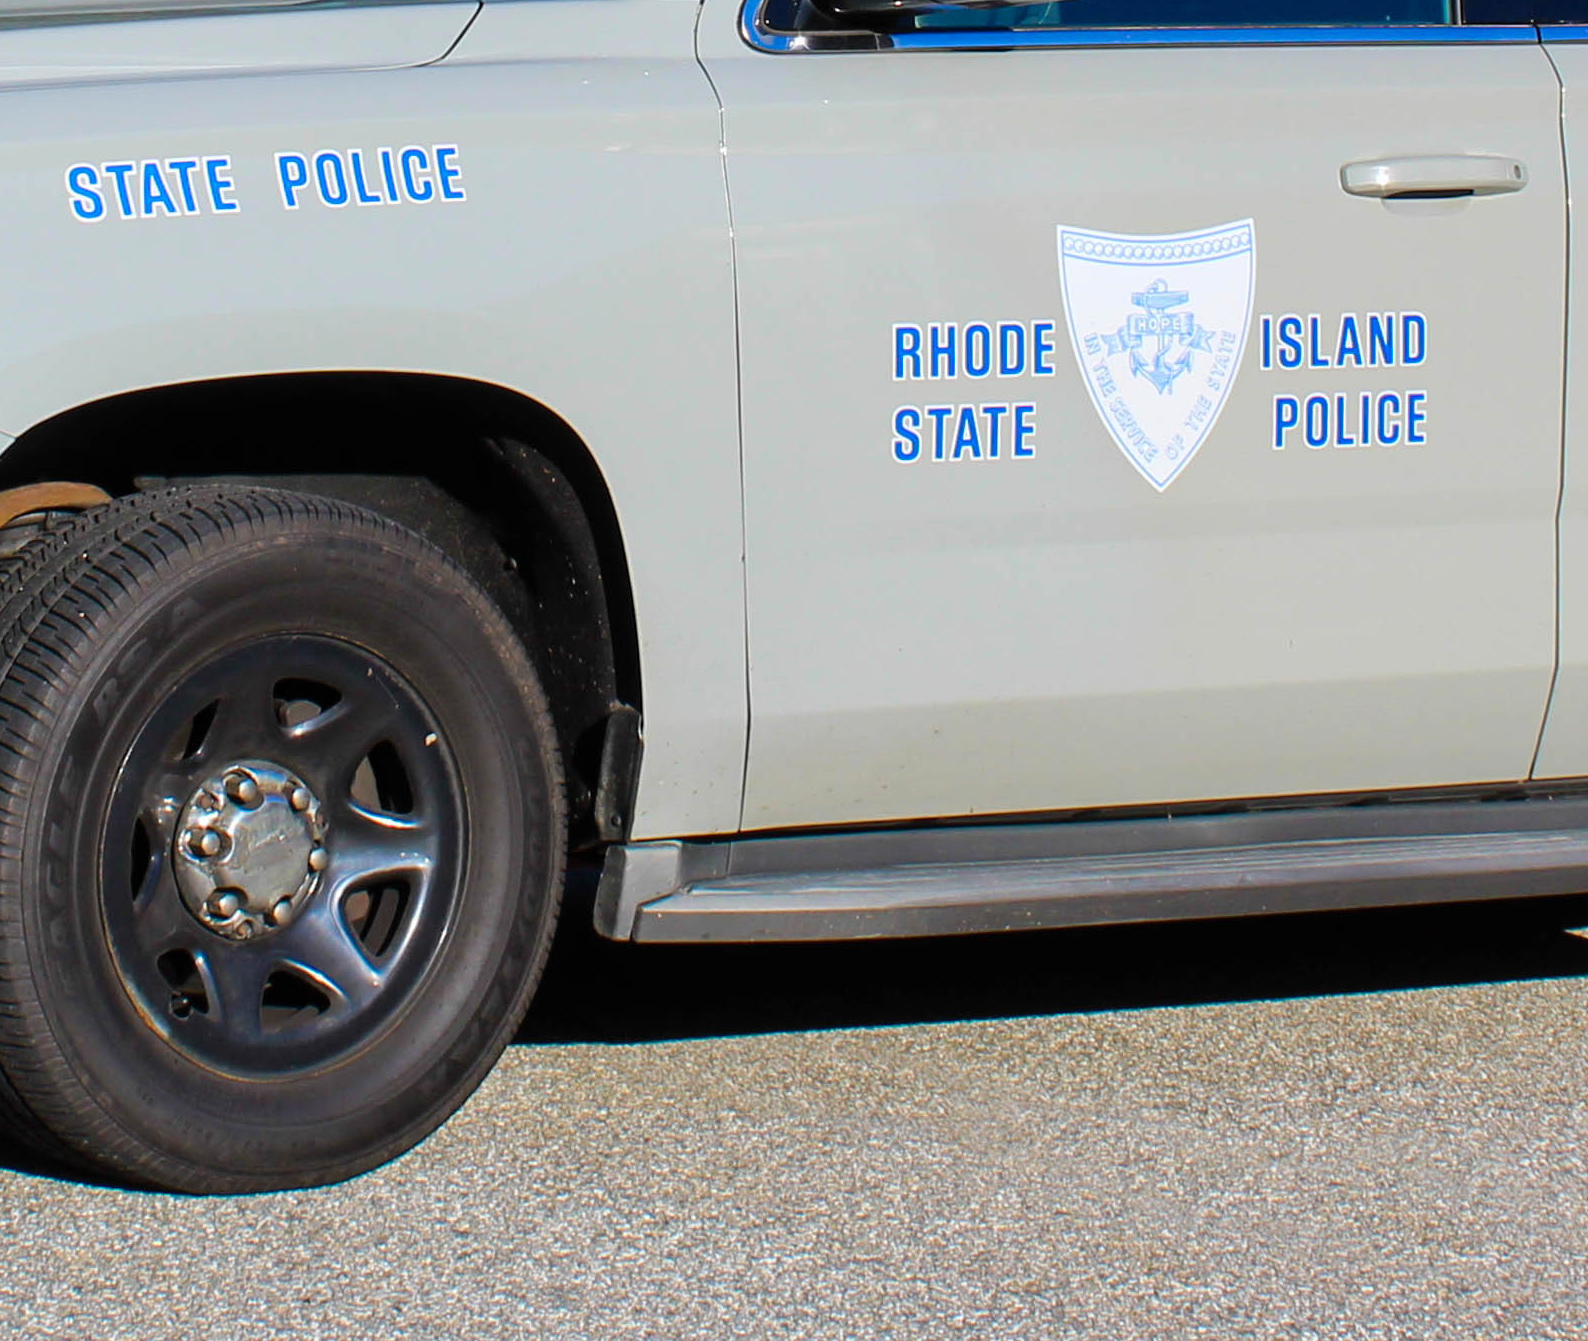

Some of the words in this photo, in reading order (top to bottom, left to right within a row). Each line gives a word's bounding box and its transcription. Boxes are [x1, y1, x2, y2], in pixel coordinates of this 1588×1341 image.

[66, 155, 240, 222] STATE
[275, 144, 466, 210] POLICE
[892, 319, 1055, 381] RHODE
[1260, 312, 1428, 371] ISLAND
[1138, 317, 1181, 331] HOPE
[892, 403, 1037, 463] STATE
[1273, 392, 1428, 450] POLICE
[1084, 332, 1101, 355] IN
[1093, 358, 1117, 398] THE
[1110, 397, 1159, 464] SERVICE
[1166, 434, 1186, 461] OF
[1184, 395, 1212, 431] THE
[1207, 331, 1237, 391] STATE
